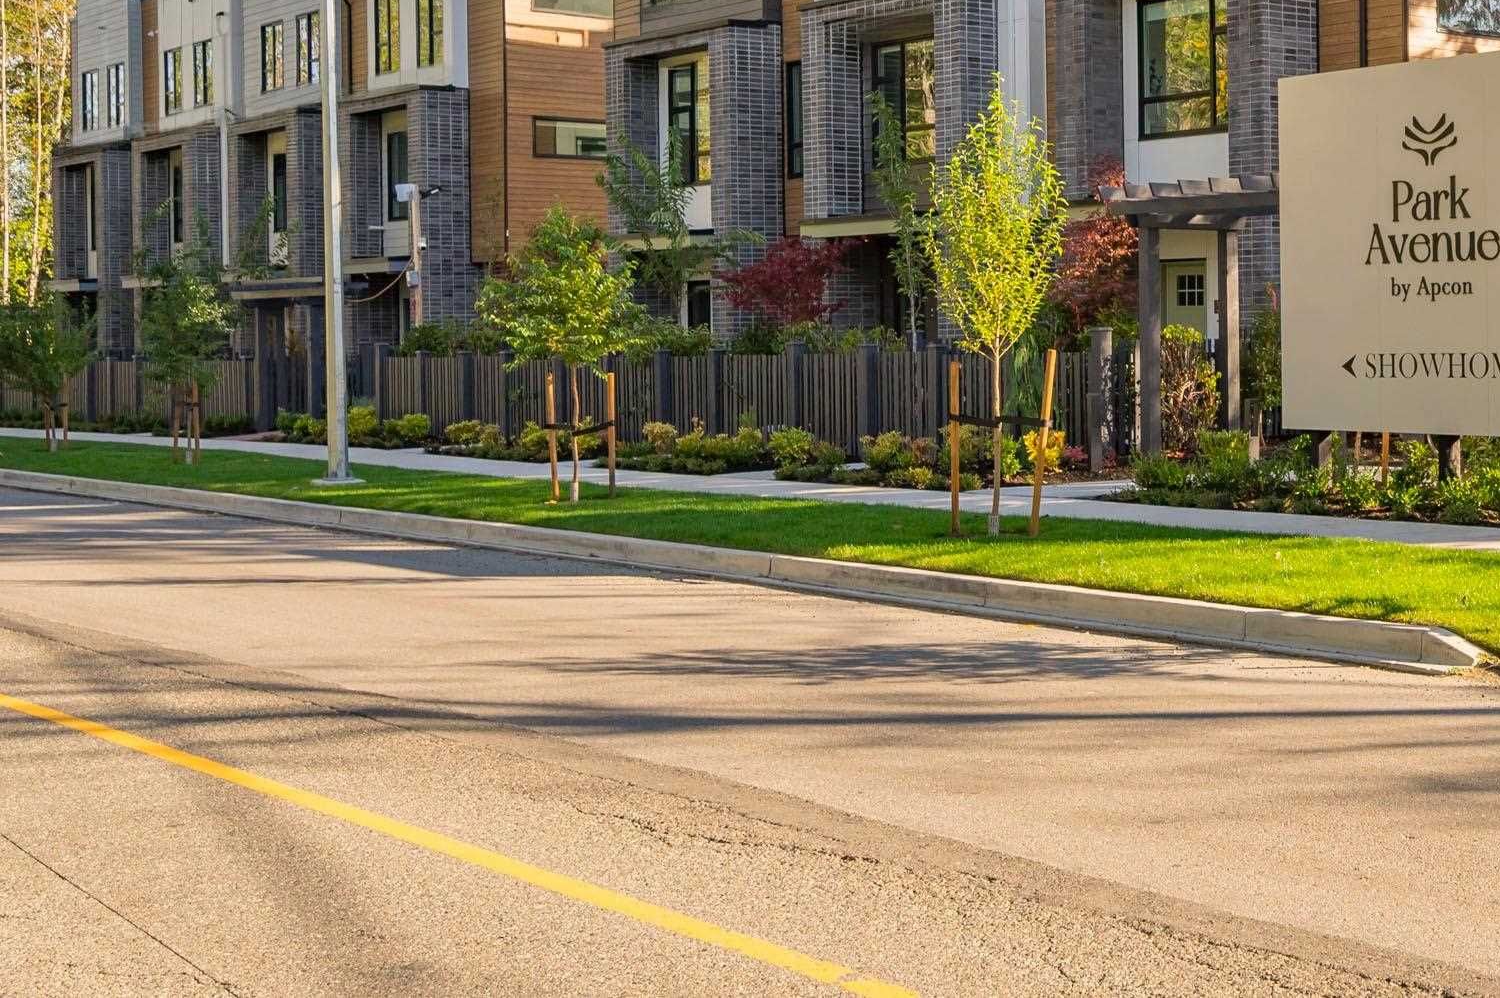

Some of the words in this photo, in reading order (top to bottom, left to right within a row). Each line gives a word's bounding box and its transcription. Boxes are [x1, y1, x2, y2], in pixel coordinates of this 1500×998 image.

[1391, 174, 1472, 223] Park
[1364, 222, 1500, 266] Avenue
[1390, 276, 1412, 303] by
[1416, 275, 1474, 303] Apcon
